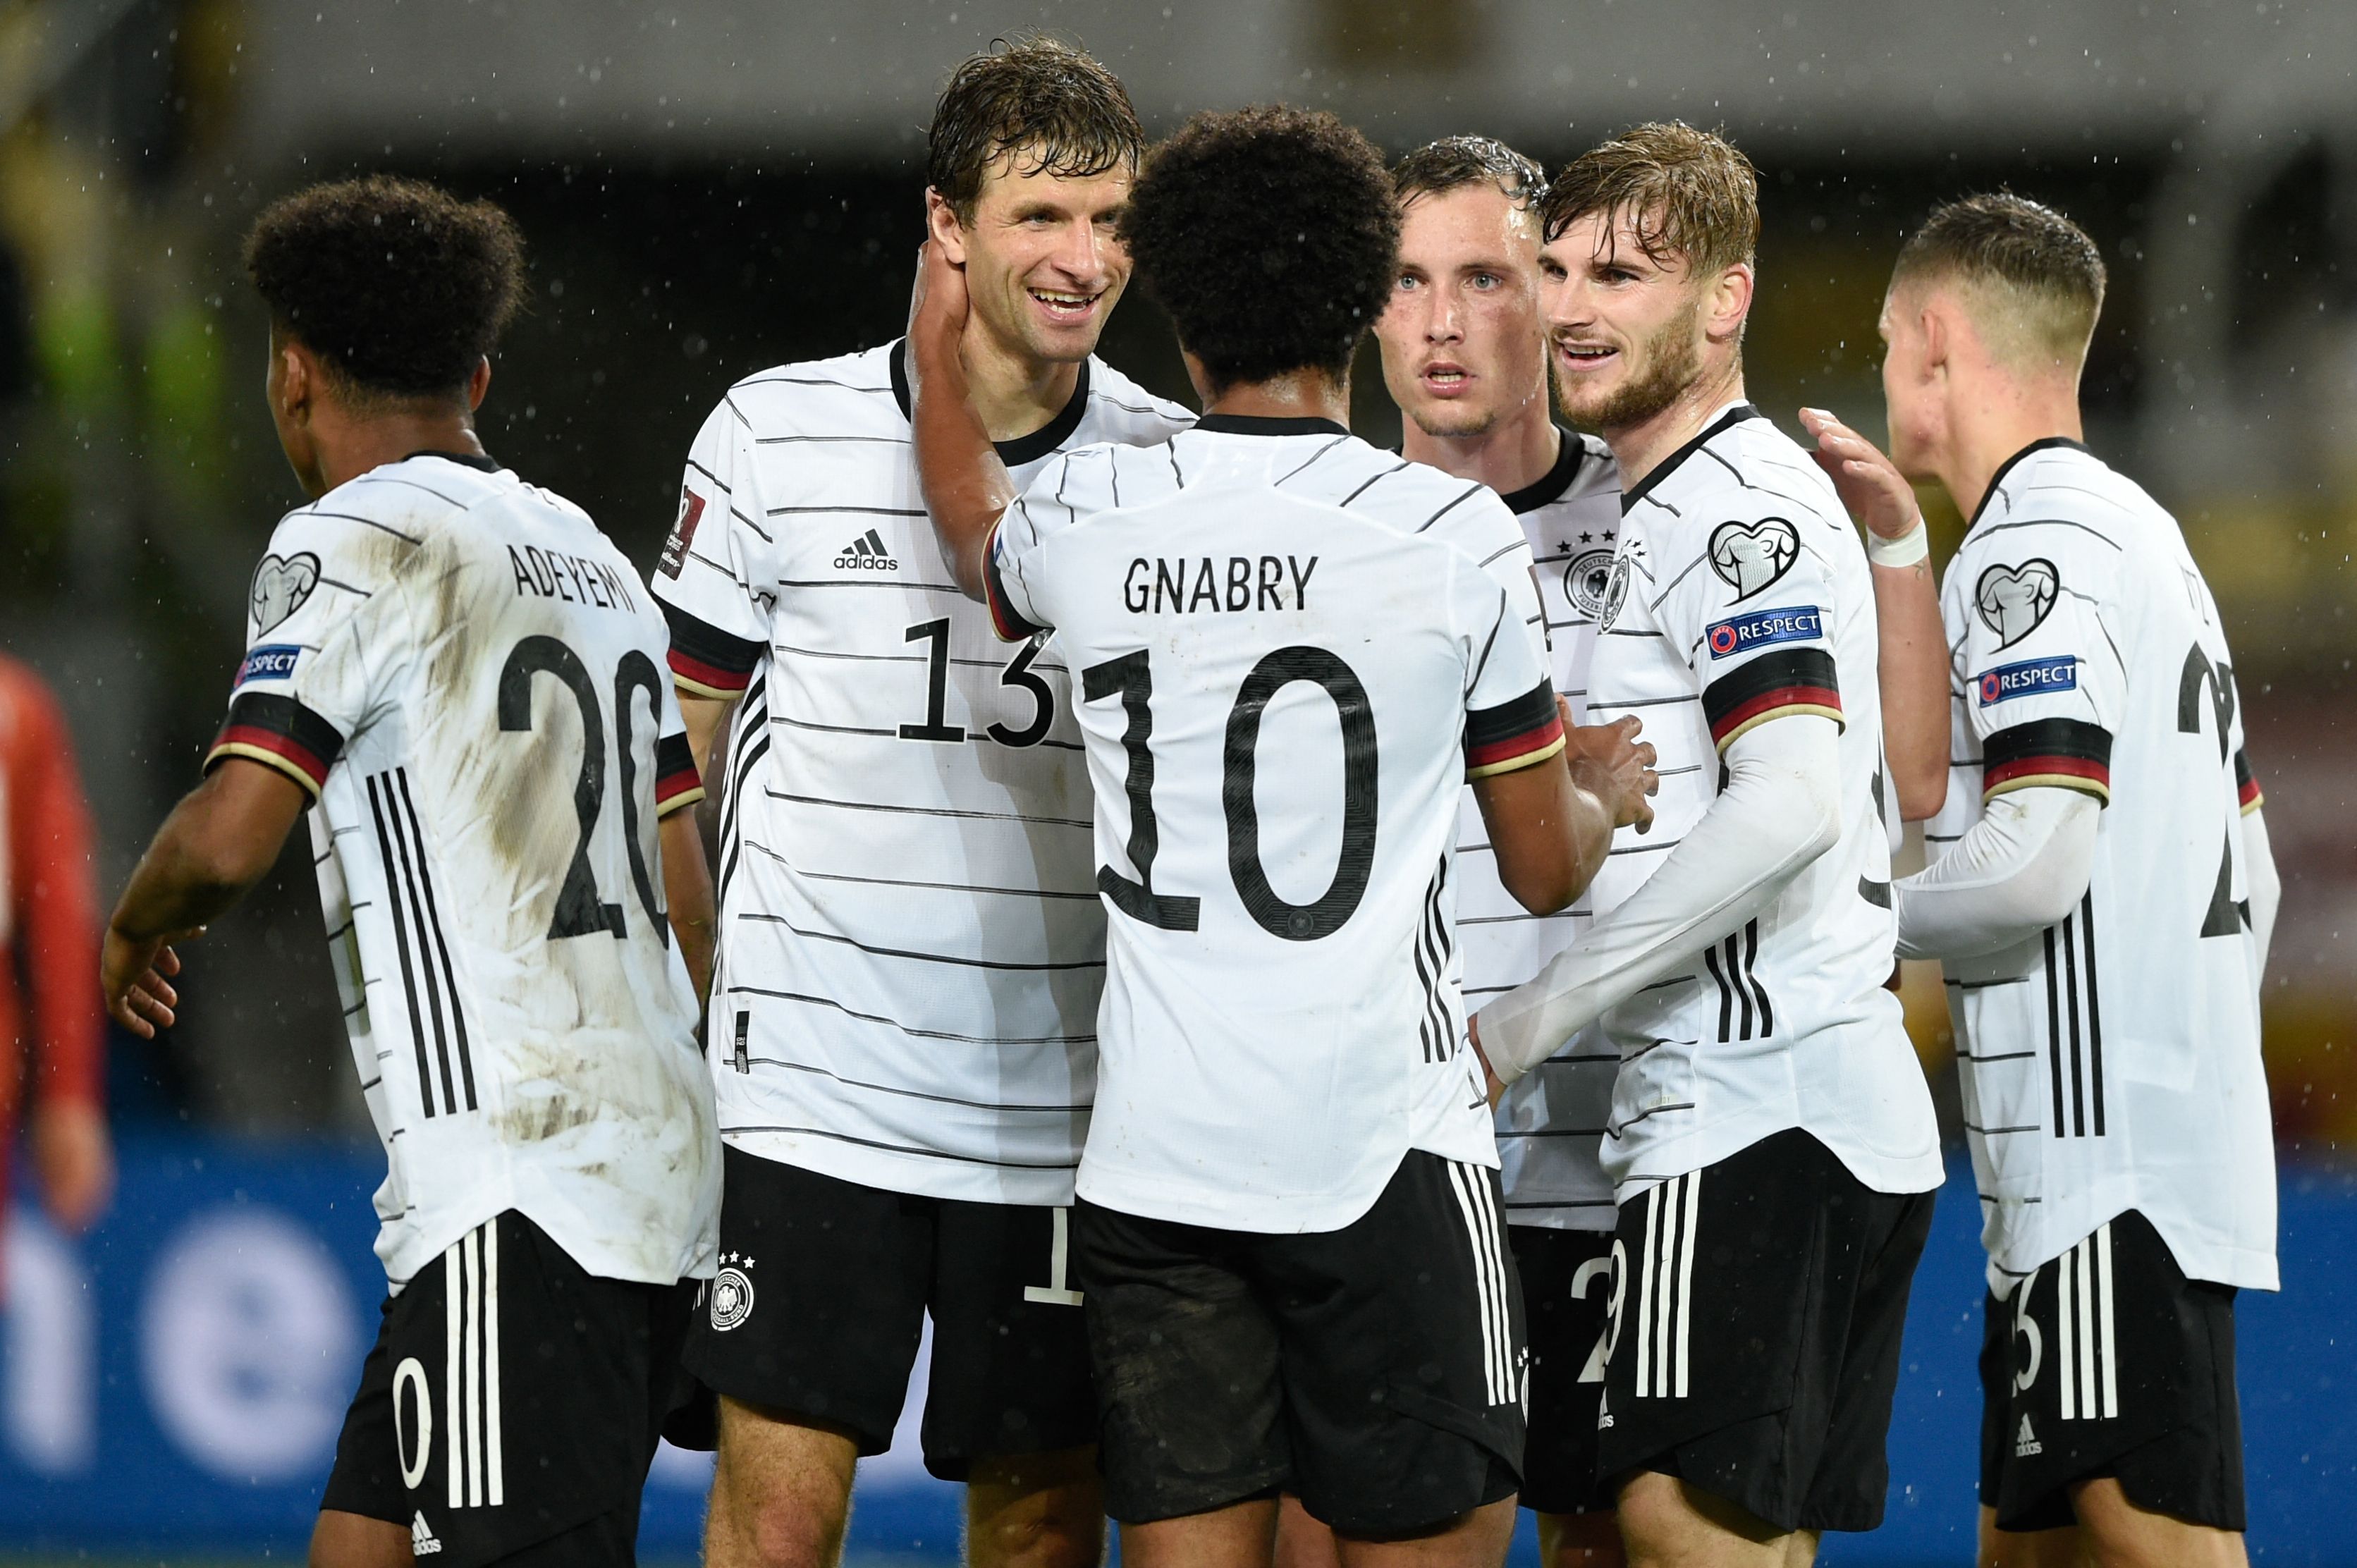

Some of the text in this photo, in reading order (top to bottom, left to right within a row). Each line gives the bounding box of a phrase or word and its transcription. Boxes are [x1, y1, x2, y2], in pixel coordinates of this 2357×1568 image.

[506, 544, 637, 614] ADEYEMI
[833, 554, 898, 570] adidas
[1123, 555, 1318, 614] GNABRY
[1577, 558, 1613, 574] DEUTSCH
[1739, 615, 1818, 641] RESPECT
[898, 617, 1055, 747] 13
[2001, 665, 2074, 691] RESPECT
[498, 635, 670, 950] 20
[1082, 644, 1378, 941] 10
[2178, 639, 2253, 939] 2
[1606, 1239, 1627, 1365] 9
